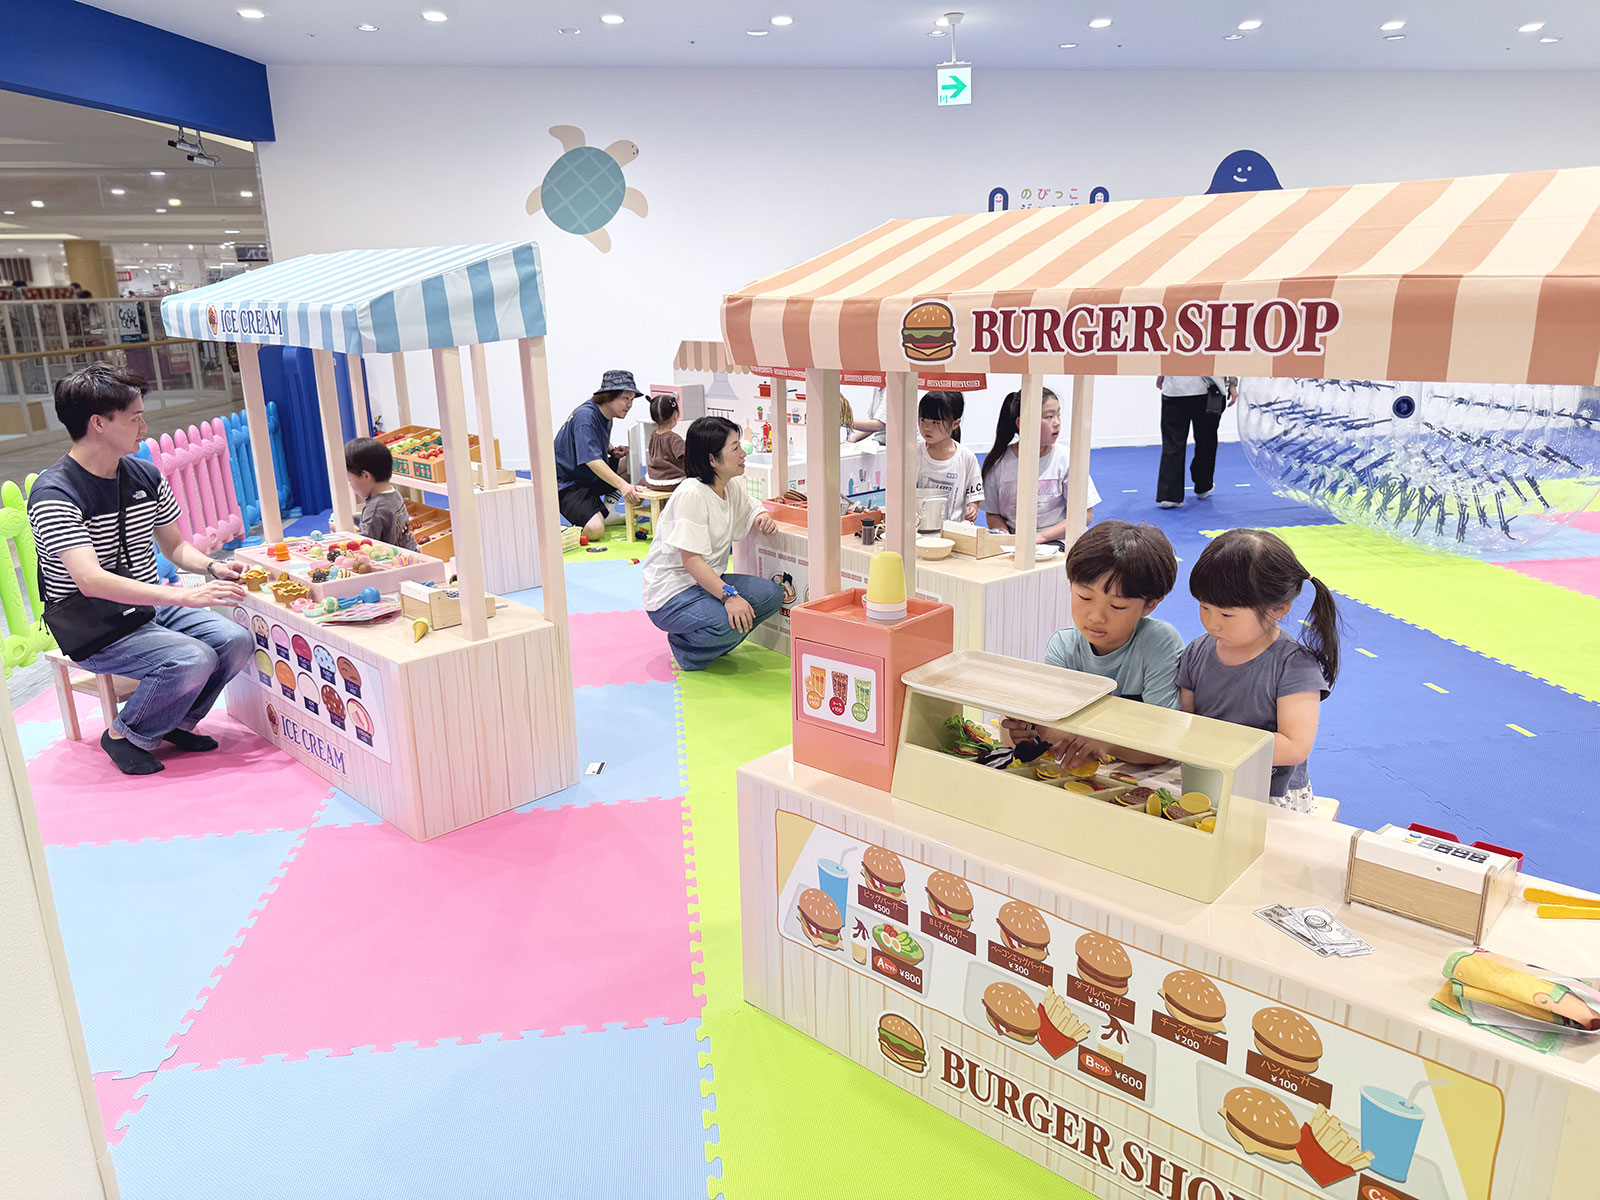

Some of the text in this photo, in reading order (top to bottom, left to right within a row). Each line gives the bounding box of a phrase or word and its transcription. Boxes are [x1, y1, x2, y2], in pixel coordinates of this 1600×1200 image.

[1021, 188, 1078, 201] のびっこ
[220, 309, 283, 336] ICE CREAM
[971, 301, 1339, 354] BURGER SHOP
[281, 714, 347, 775] ICE CREAM
[863, 889, 904, 911] ビッグバーガー
[873, 902, 891, 915] ¥500
[929, 917, 969, 939] BLTバーガー
[938, 930, 958, 945] ¥400
[899, 968, 921, 986] ¥800
[1008, 960, 1030, 977] ¥300
[1074, 979, 1129, 1008] ダブルバーガー
[1087, 995, 1111, 1012] ¥300
[1159, 1016, 1222, 1047] チーズバーガー
[1173, 1032, 1200, 1050] ¥200
[1114, 1069, 1143, 1091] ¥600
[1260, 1059, 1320, 1089] ハンバーガー
[1270, 1073, 1298, 1092] ¥100
[940, 1045, 1114, 1171] BURGER
